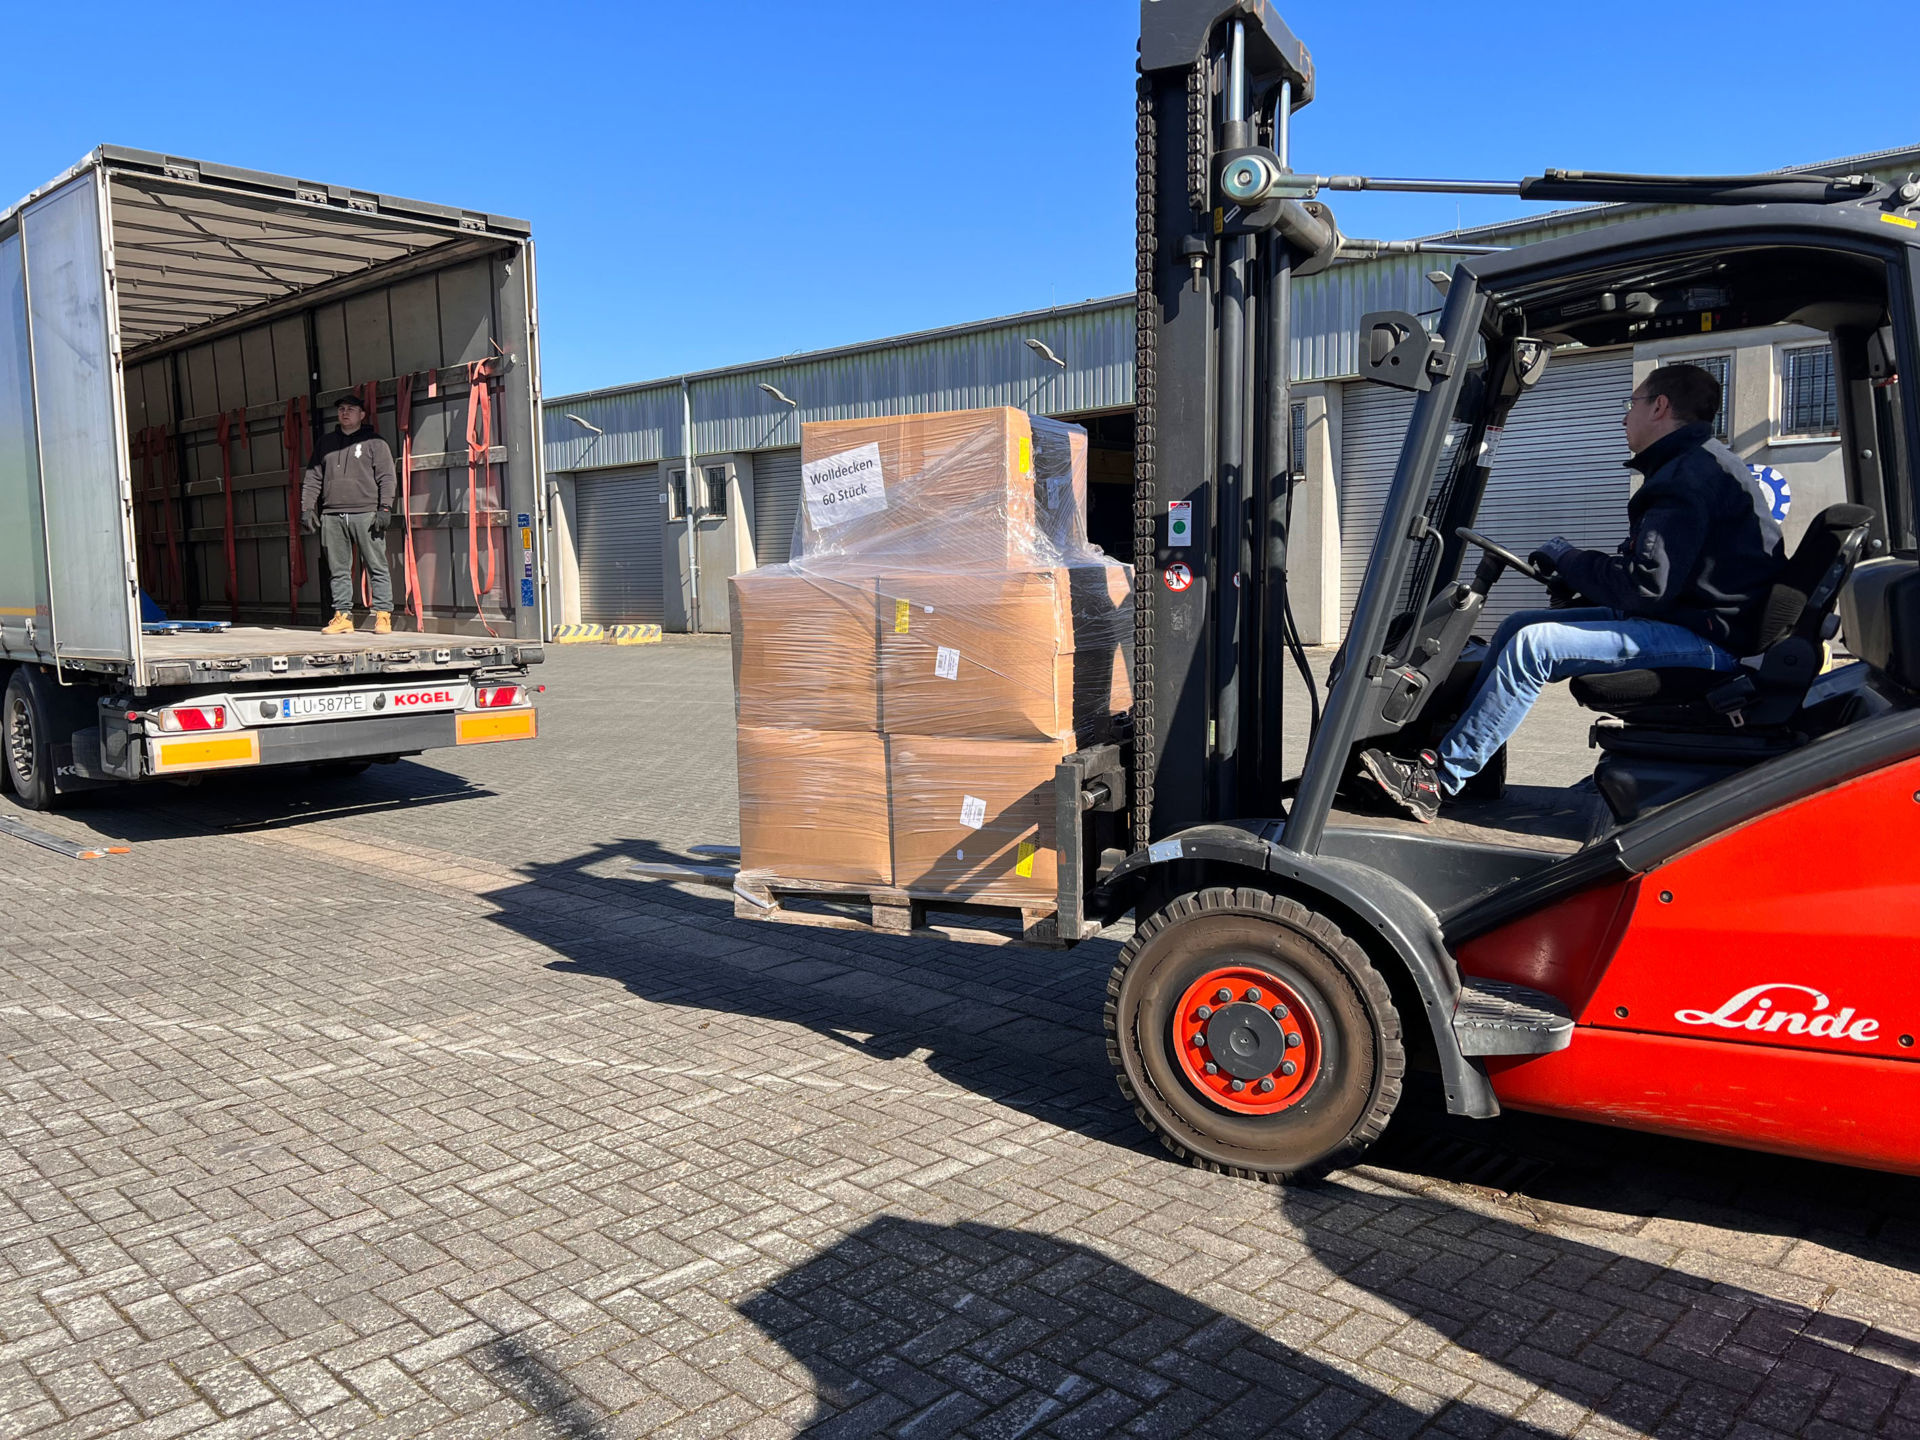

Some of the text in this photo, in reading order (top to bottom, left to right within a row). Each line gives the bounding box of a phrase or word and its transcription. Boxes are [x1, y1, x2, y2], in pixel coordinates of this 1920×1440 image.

[810, 459, 873, 486] Wolldecken
[822, 484, 868, 506] 60 Stück
[294, 698, 313, 714] LU
[318, 694, 363, 712] 587PE
[394, 691, 454, 706] KÖGEL
[1674, 983, 1880, 1041] Linde
